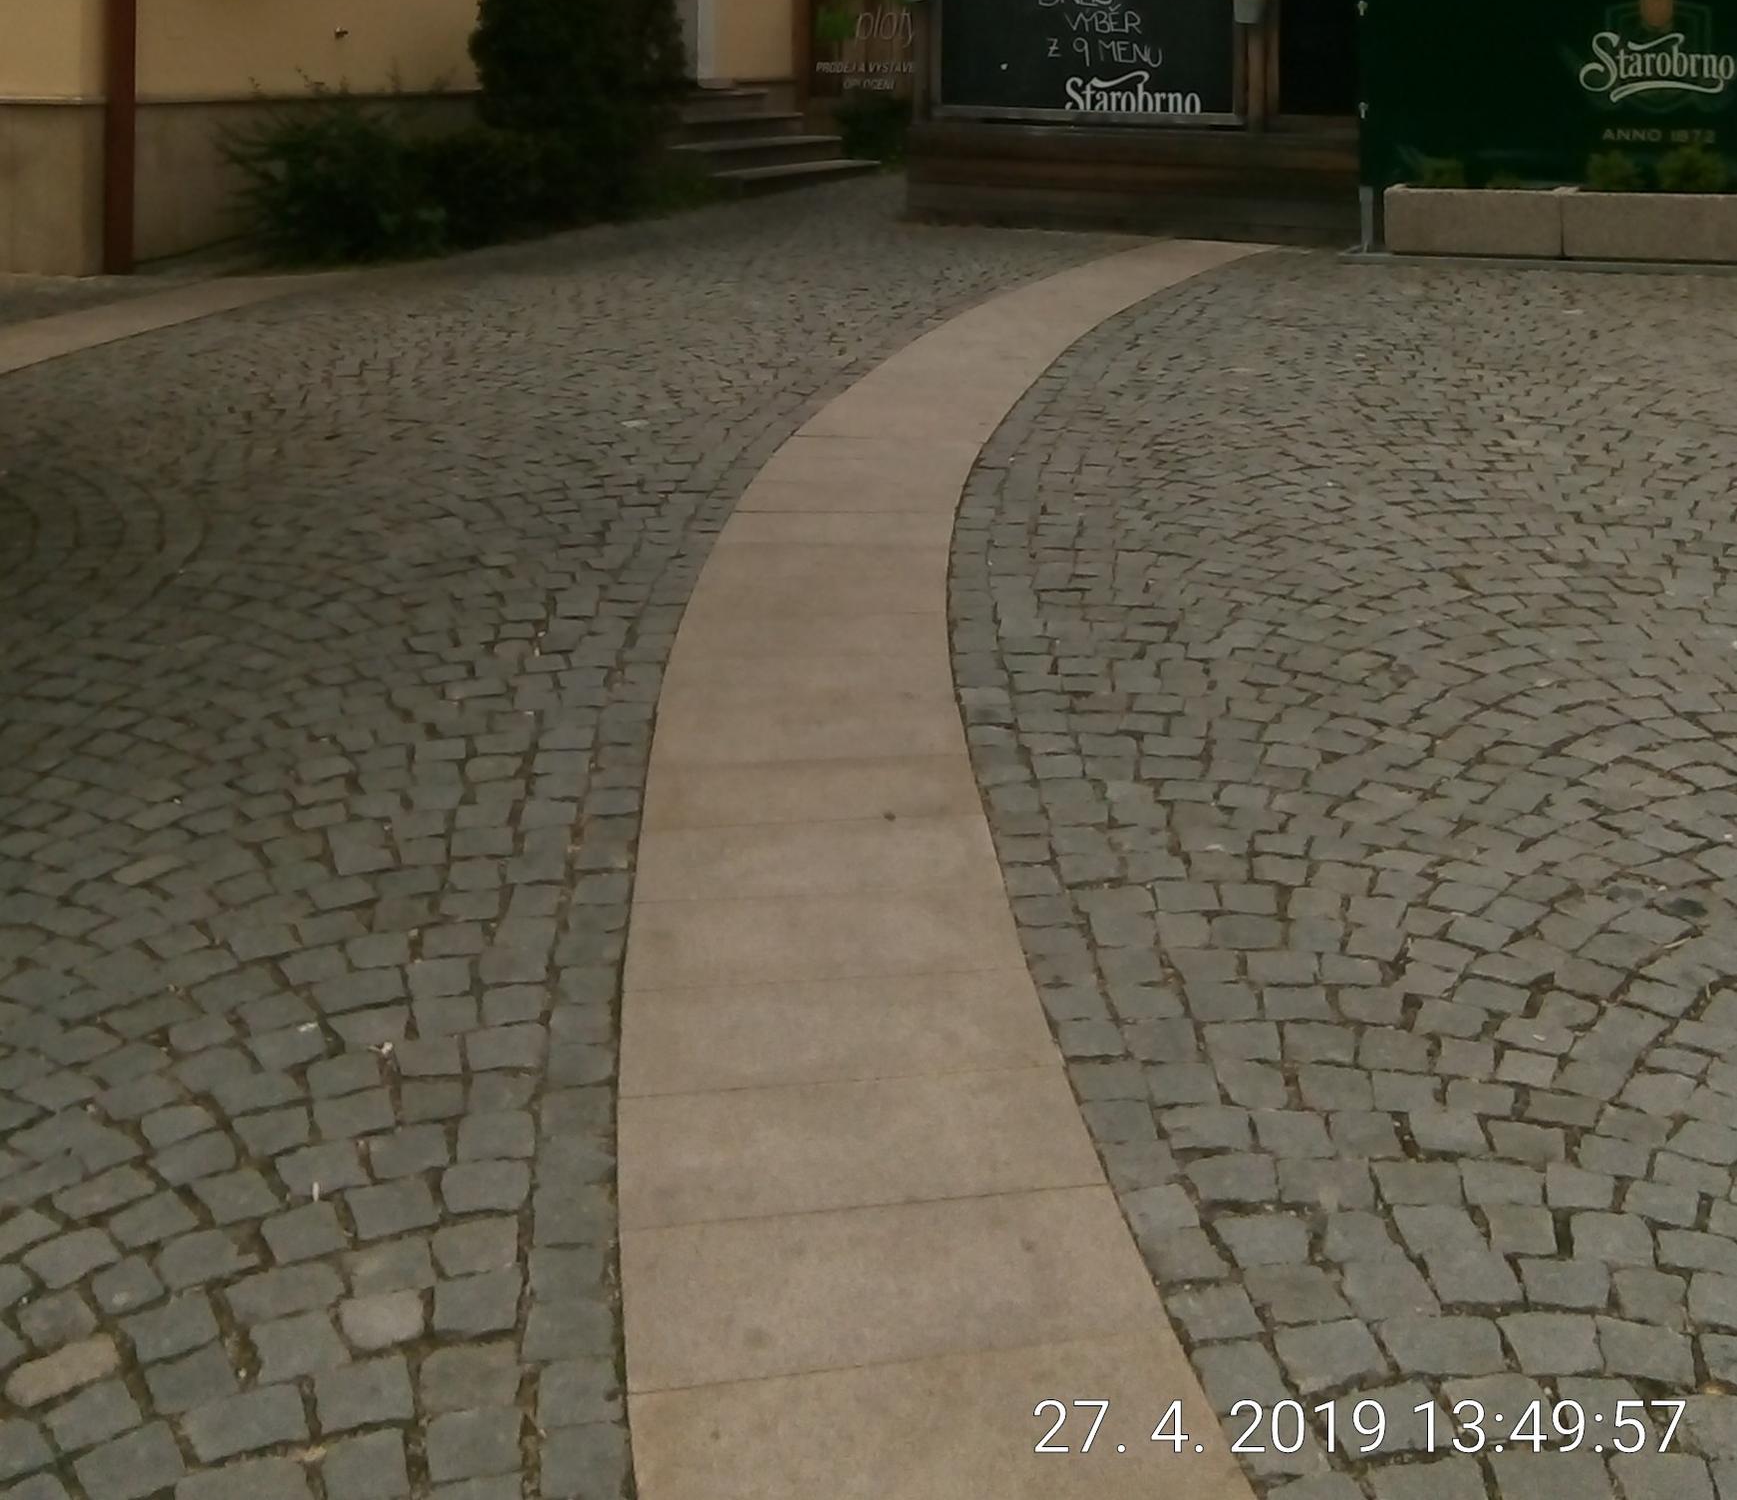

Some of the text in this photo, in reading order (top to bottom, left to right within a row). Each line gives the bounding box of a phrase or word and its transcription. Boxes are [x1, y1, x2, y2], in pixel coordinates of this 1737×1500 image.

[1072, 37, 1090, 67] 9
[1098, 39, 1163, 68] MENU
[1579, 31, 1735, 103] Starobrno
[1065, 70, 1202, 113] Starobrno
[1602, 128, 1663, 142] ANNO
